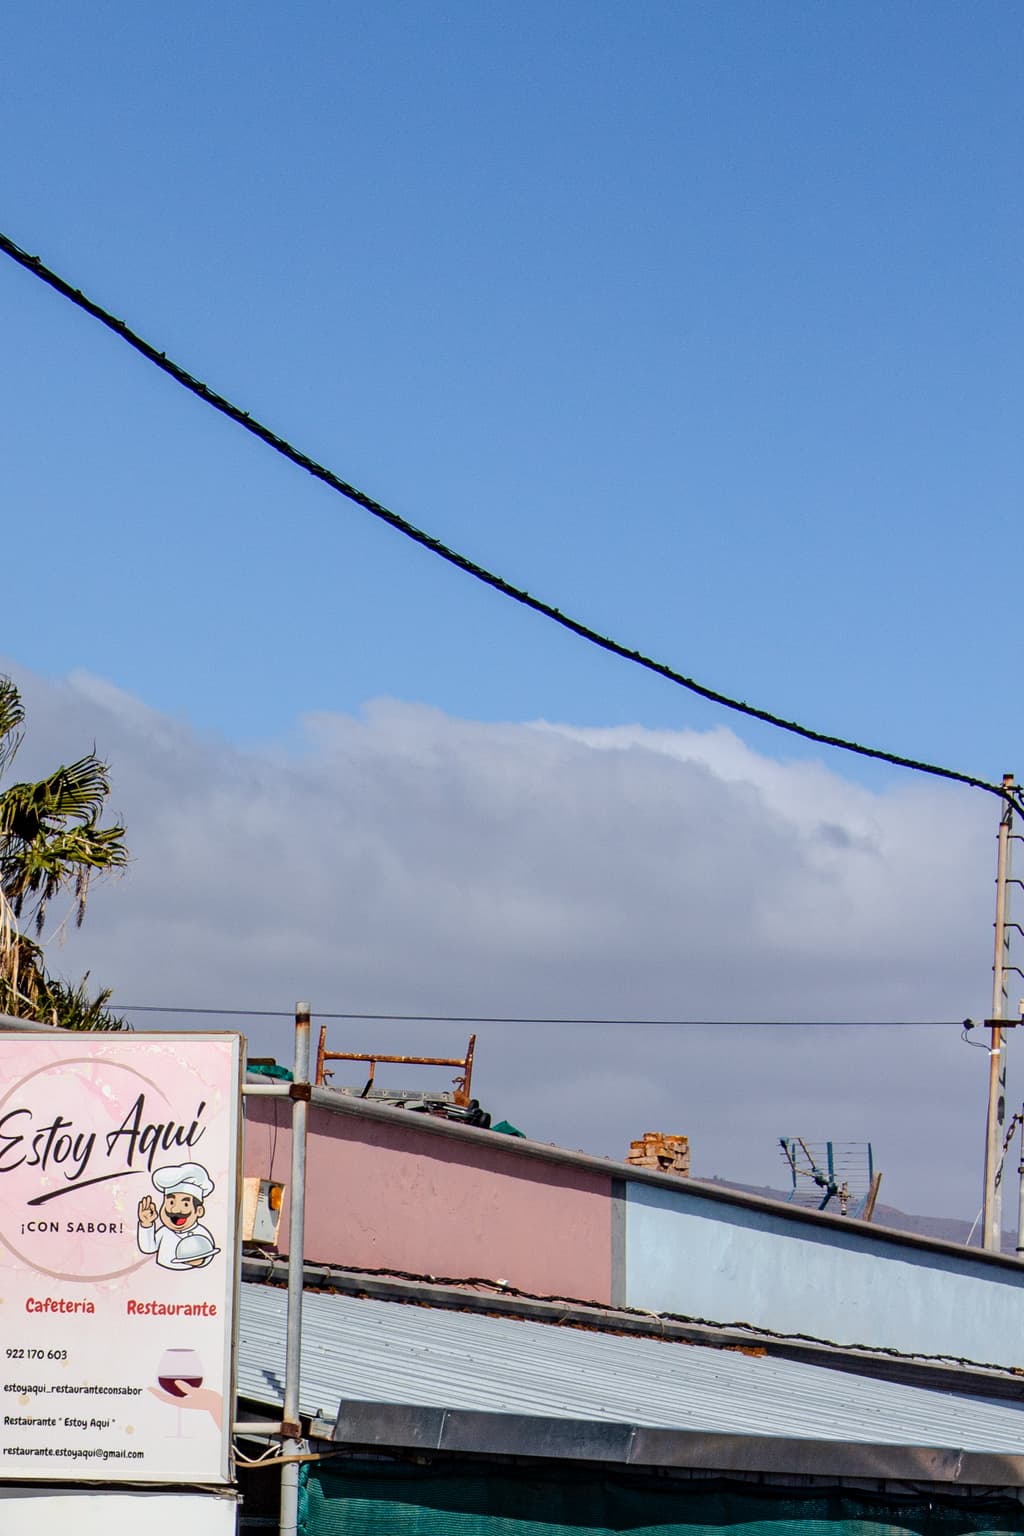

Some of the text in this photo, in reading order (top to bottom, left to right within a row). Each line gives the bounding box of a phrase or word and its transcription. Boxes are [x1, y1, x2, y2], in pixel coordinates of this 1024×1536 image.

[106, 1093, 206, 1173] Aquí
[21, 1220, 124, 1235] ¡CON SABOR!
[127, 1300, 217, 1316] Restaurante
[6, 1348, 68, 1361] 922 170 603
[3, 1384, 143, 1399] estoyaqui_restauranteconsabor
[4, 1416, 57, 1427] Restaurante
[64, 1417, 88, 1429] Estoy
[3, 1447, 145, 1461] restaurante.estoyaqui@gmail.com
